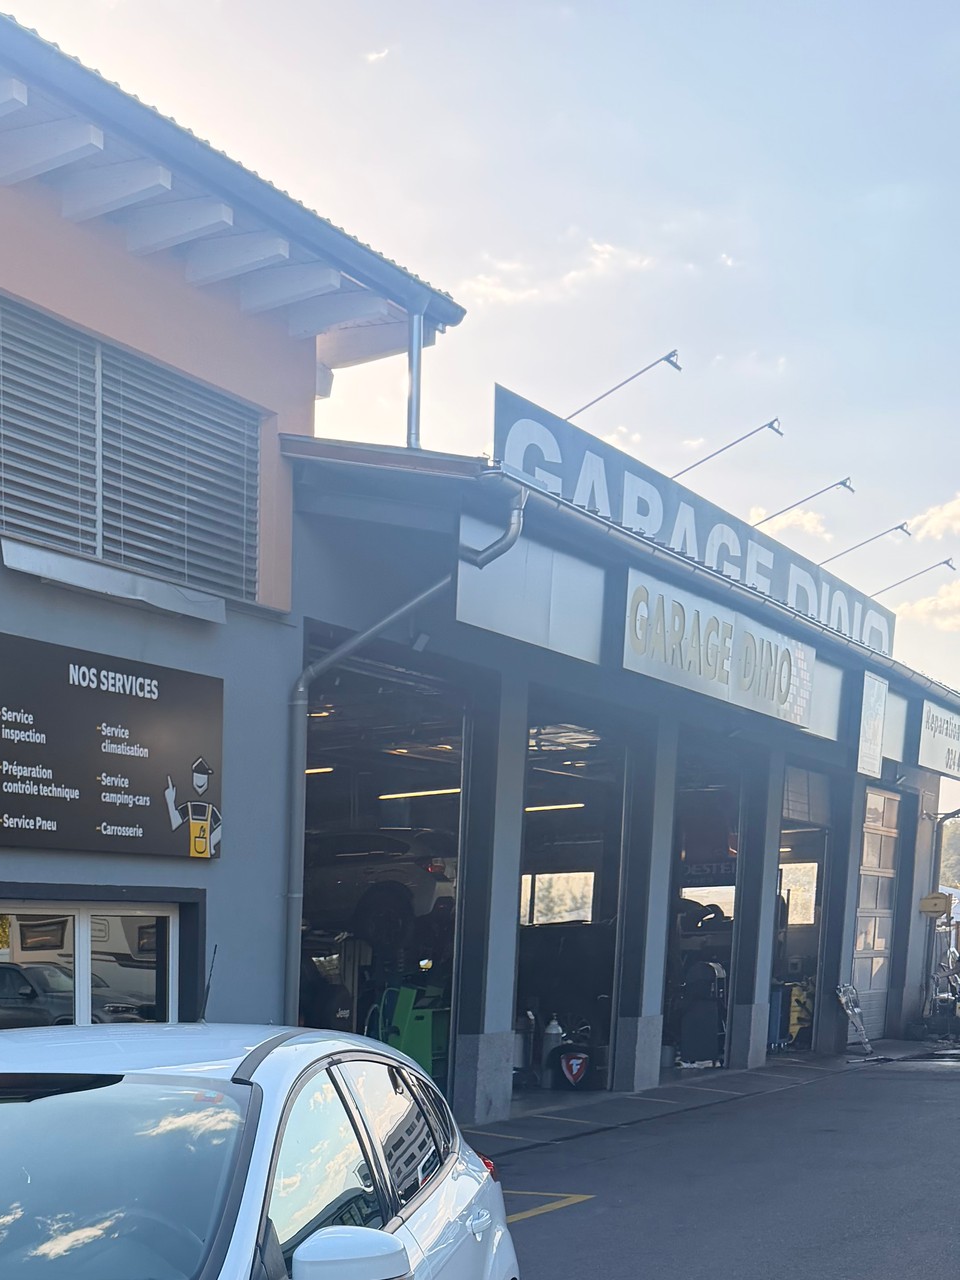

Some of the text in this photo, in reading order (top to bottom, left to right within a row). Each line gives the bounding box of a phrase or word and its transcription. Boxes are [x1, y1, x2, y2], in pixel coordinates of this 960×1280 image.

[629, 585, 792, 706] GARAGE DINO
[69, 663, 159, 700] NOS SERVICES
[1, 706, 34, 725] Service
[1, 724, 46, 744] inspection
[101, 722, 130, 739] Service
[101, 739, 149, 758] climatisation
[2, 760, 53, 779] Préparation
[101, 772, 129, 788] Service
[2, 780, 80, 801] contrôle technique
[101, 791, 150, 808] camping-cars
[3, 813, 57, 831] Service Pneu
[101, 821, 143, 837] Carrosserie
